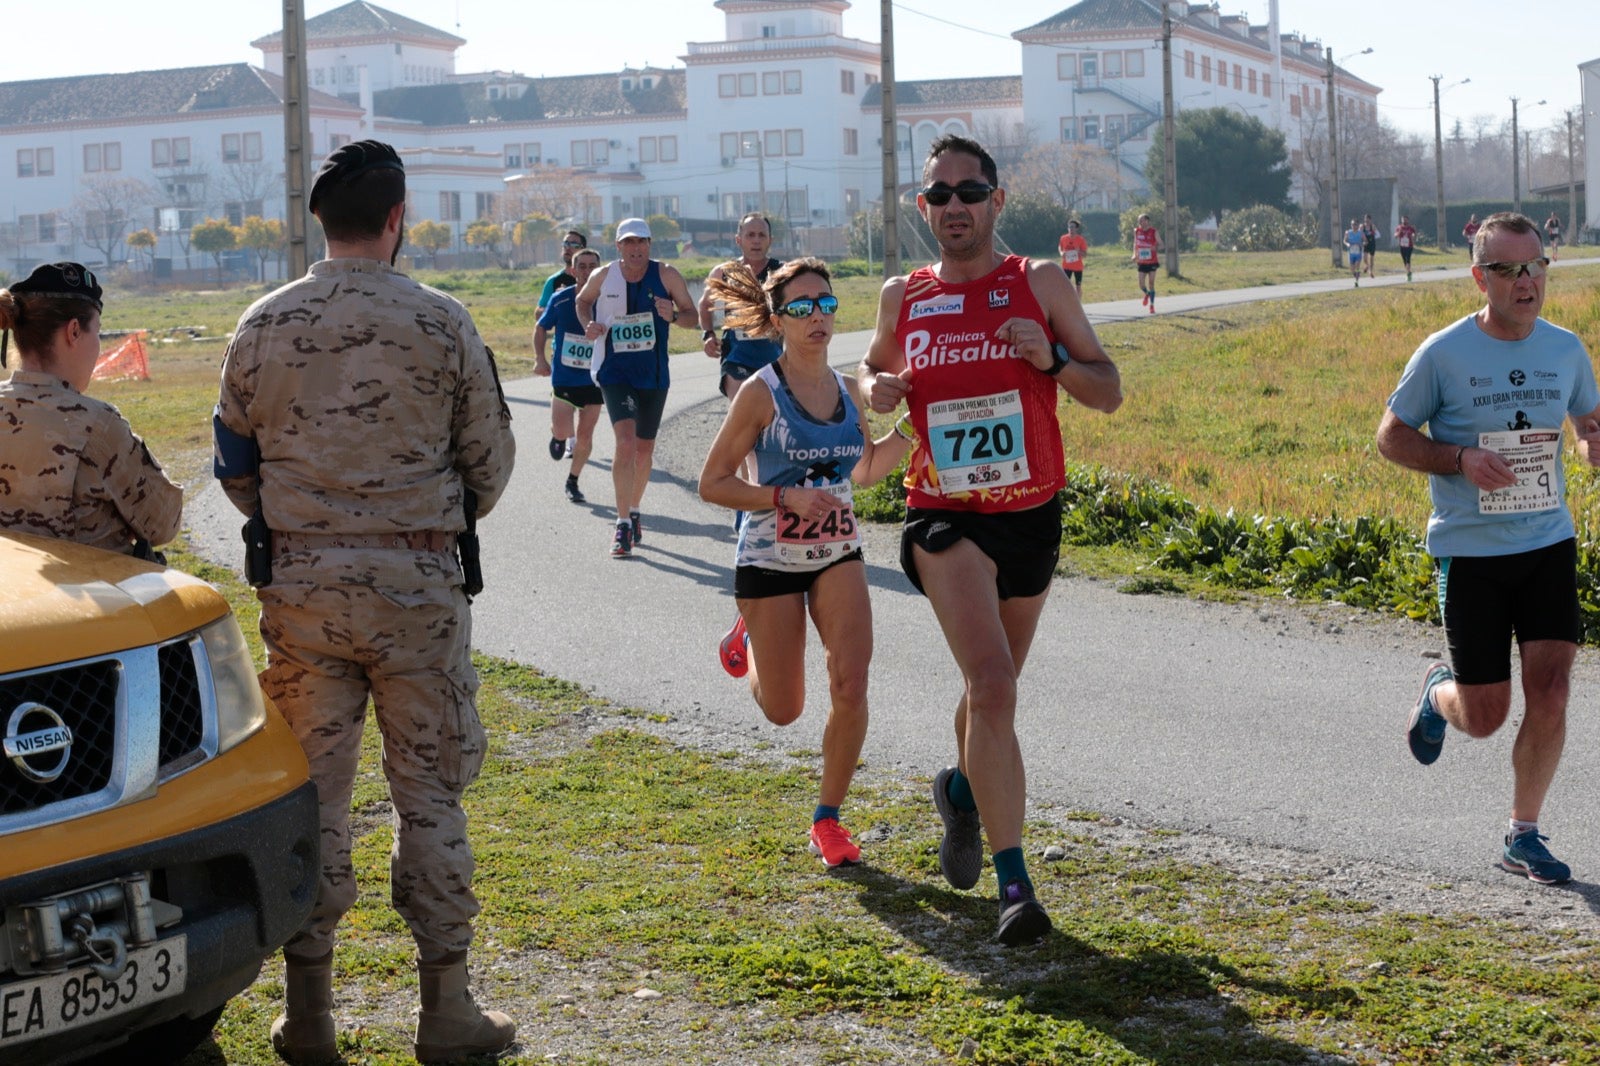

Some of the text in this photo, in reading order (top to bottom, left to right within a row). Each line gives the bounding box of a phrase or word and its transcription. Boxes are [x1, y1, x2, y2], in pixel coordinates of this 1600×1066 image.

[614, 325, 652, 340] 1086
[936, 331, 986, 345] Clínicas
[568, 344, 593, 359] 400
[949, 402, 965, 412] GRAN
[966, 399, 988, 409] PREMIO
[999, 394, 1015, 404] FONDO
[1492, 392, 1511, 404] GRAN
[1511, 390, 1534, 401] PREMIO
[1536, 389, 1544, 400] DE
[944, 423, 1013, 462] 720
[787, 447, 829, 461] TODO
[1530, 454, 1553, 463] CONTRA
[1514, 465, 1544, 473] CANCER
[781, 508, 854, 540] 2245
[16, 730, 71, 752] NISSAN
[2, 949, 171, 1039] EA 8553 3
